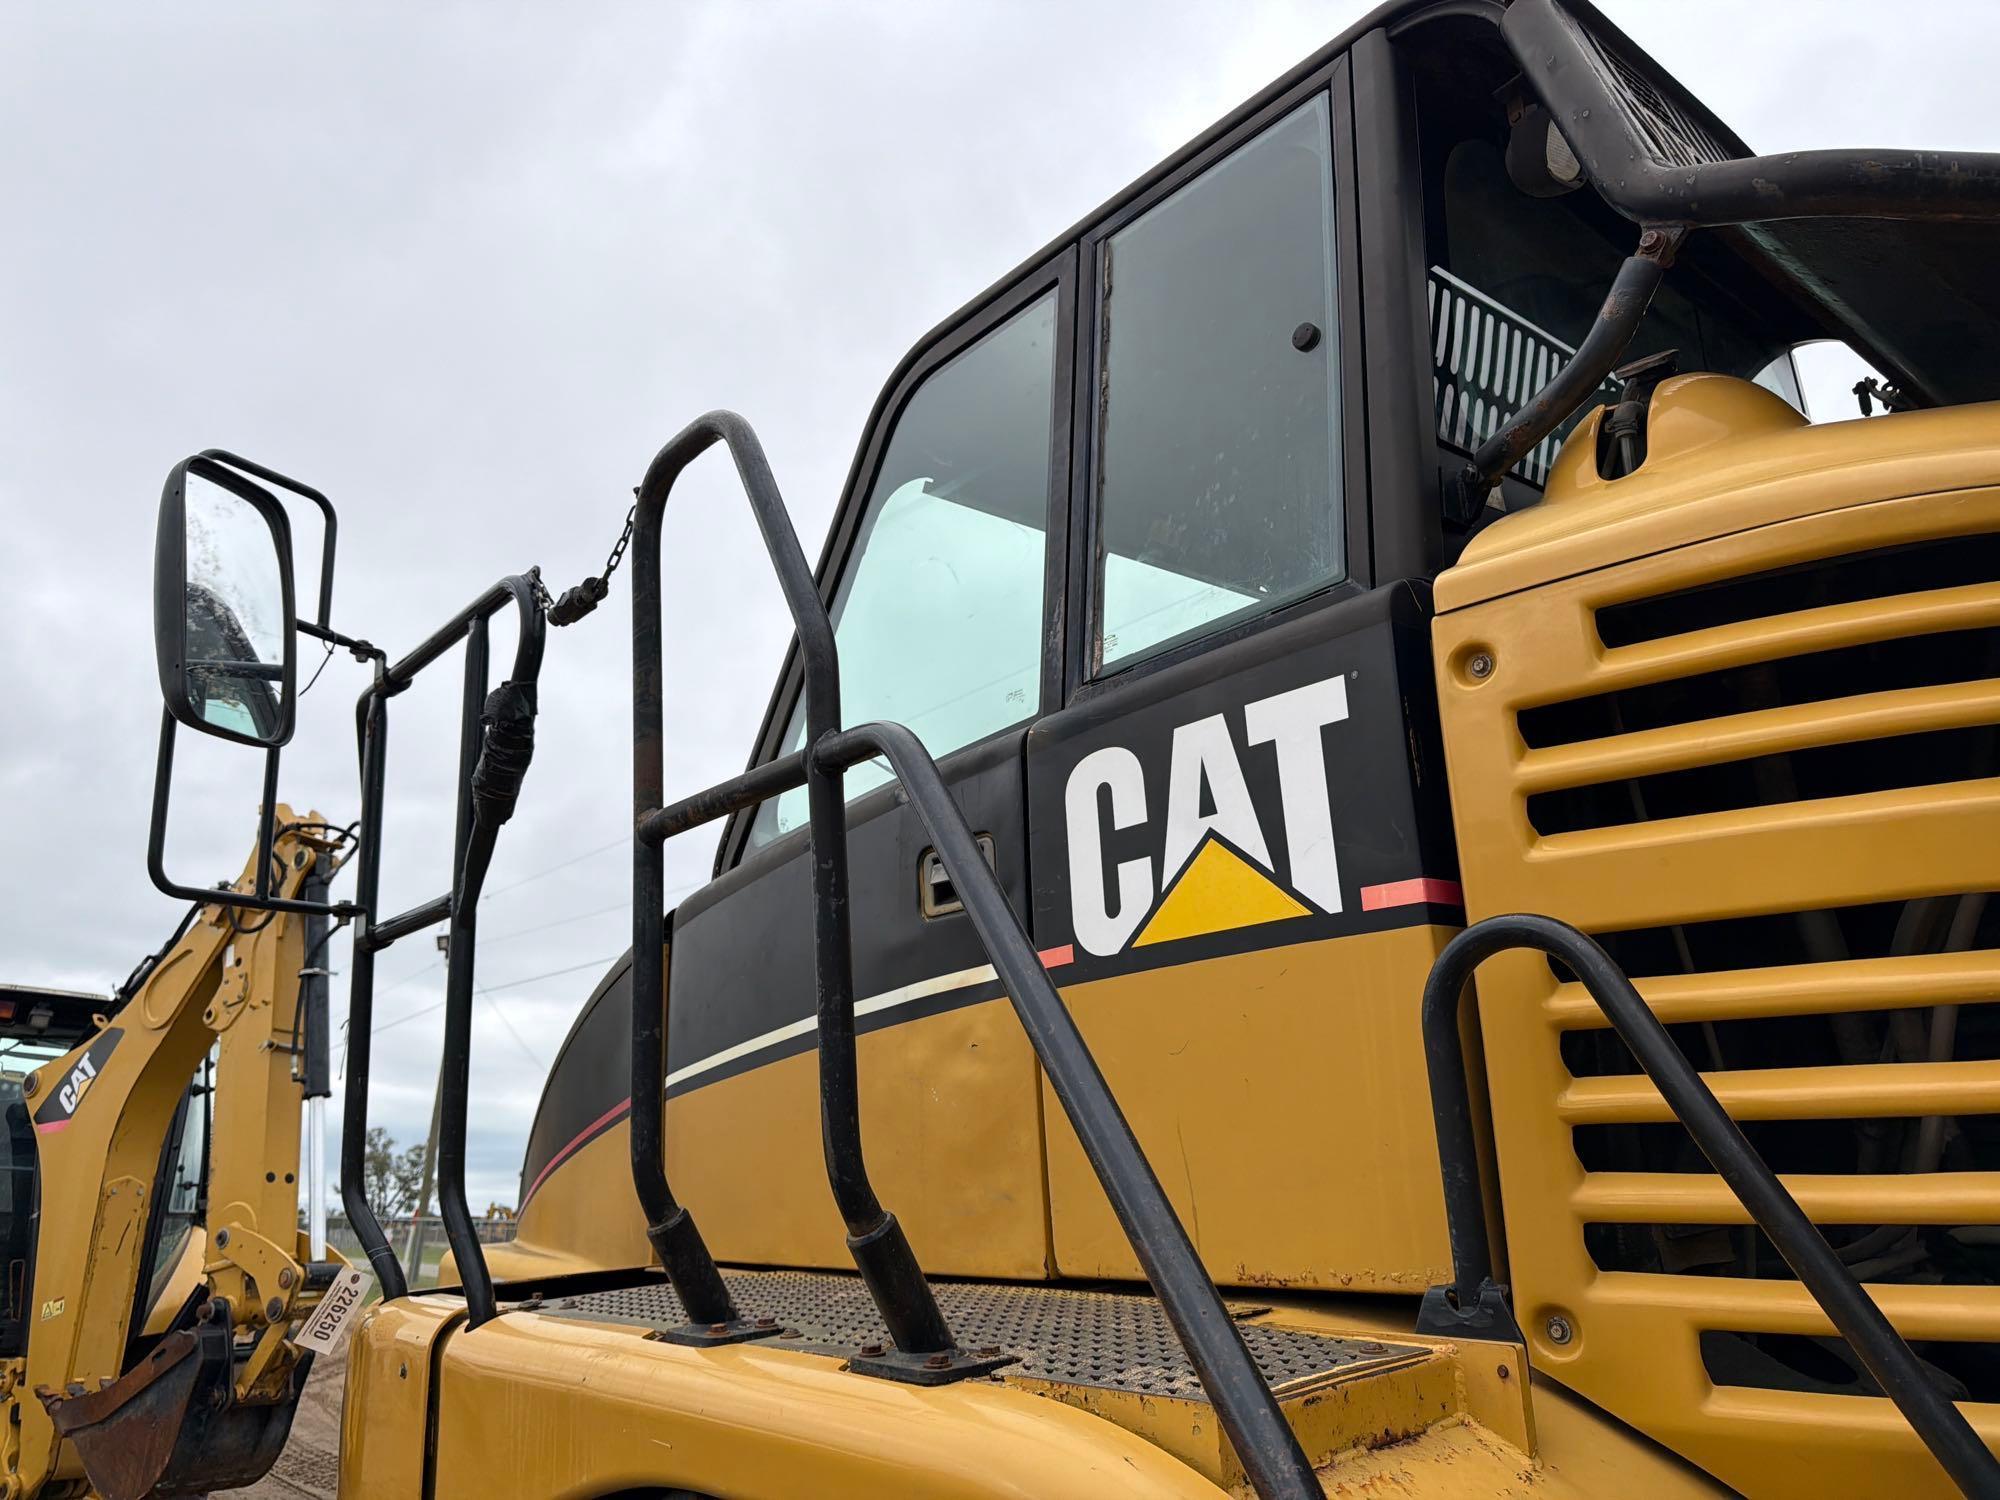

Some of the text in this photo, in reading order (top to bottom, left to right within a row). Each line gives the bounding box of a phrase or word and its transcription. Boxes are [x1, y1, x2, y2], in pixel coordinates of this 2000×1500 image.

[1065, 674, 1349, 956] CAT
[60, 1051, 96, 1114] CAT
[313, 1286, 358, 1340] 226250
